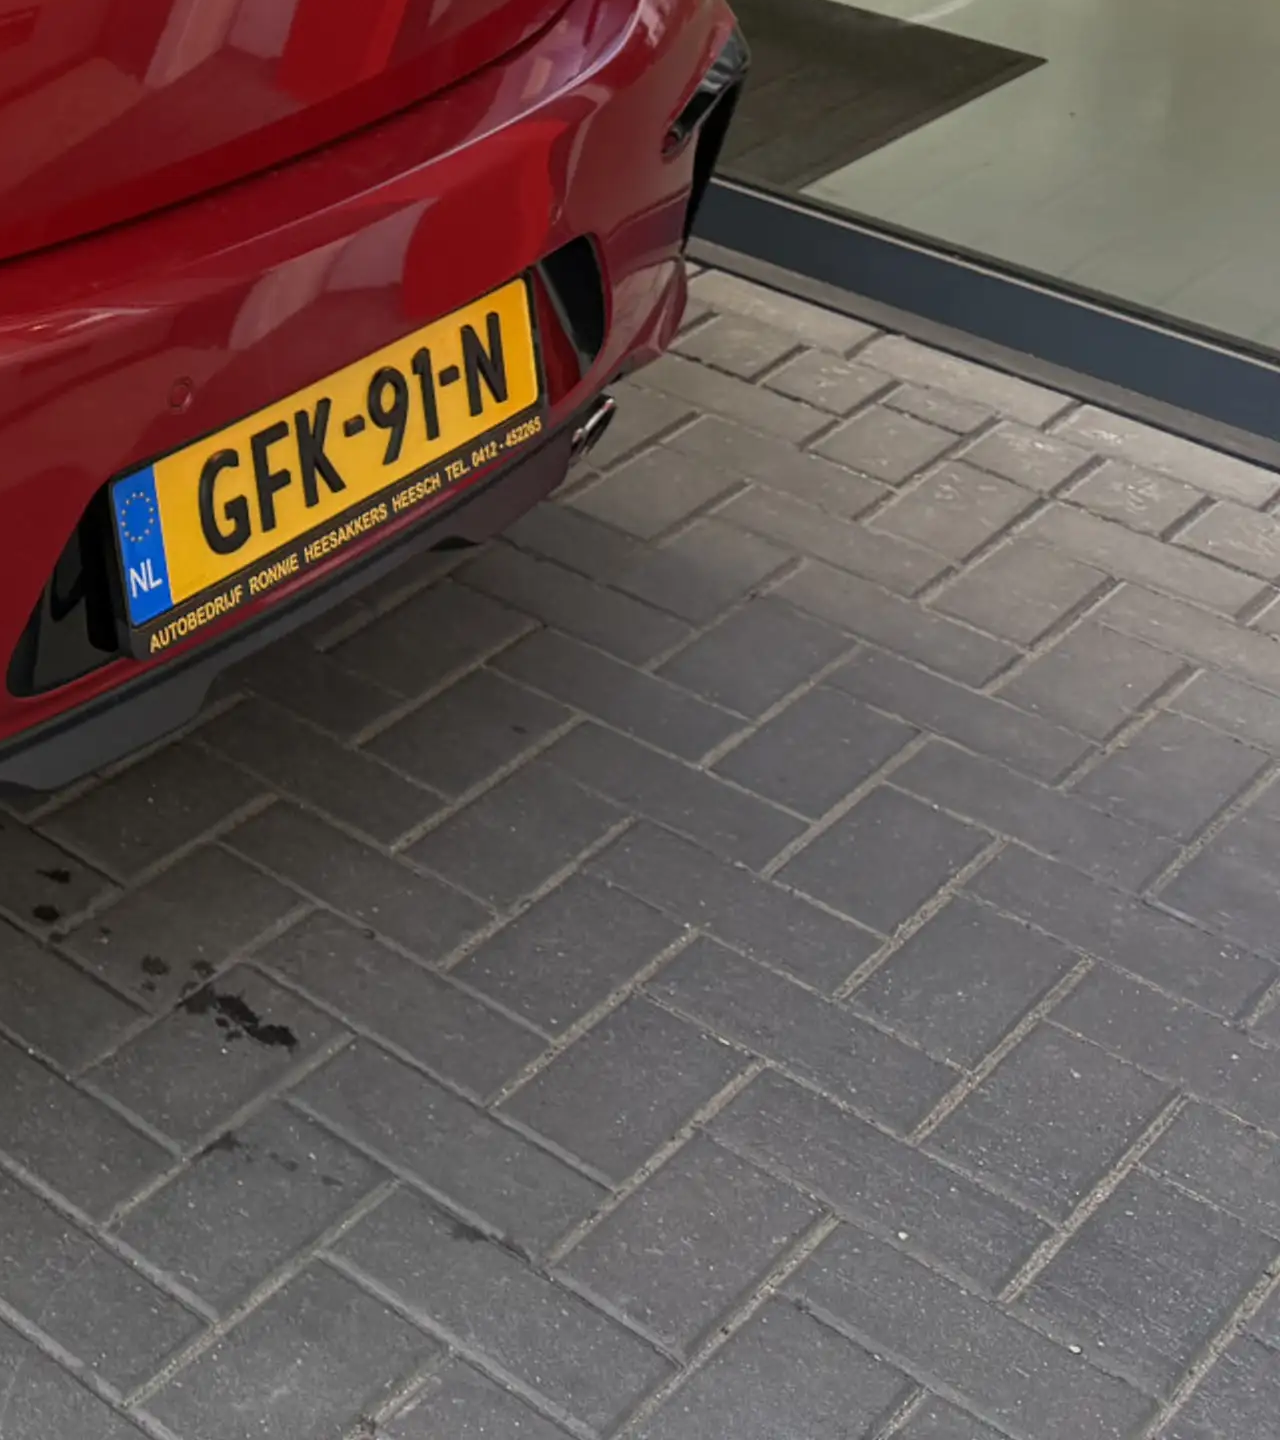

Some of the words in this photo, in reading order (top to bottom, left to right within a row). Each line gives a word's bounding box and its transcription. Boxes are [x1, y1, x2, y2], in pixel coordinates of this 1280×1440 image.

[199, 311, 508, 555] GFK-91-N
[129, 556, 162, 598] NL
[149, 584, 244, 653] AUTOBEDRIJF
[248, 553, 300, 595] RONNIE
[303, 502, 388, 564] HEESAKKERS
[392, 472, 442, 513] HEESCH
[444, 458, 471, 482] TEL.
